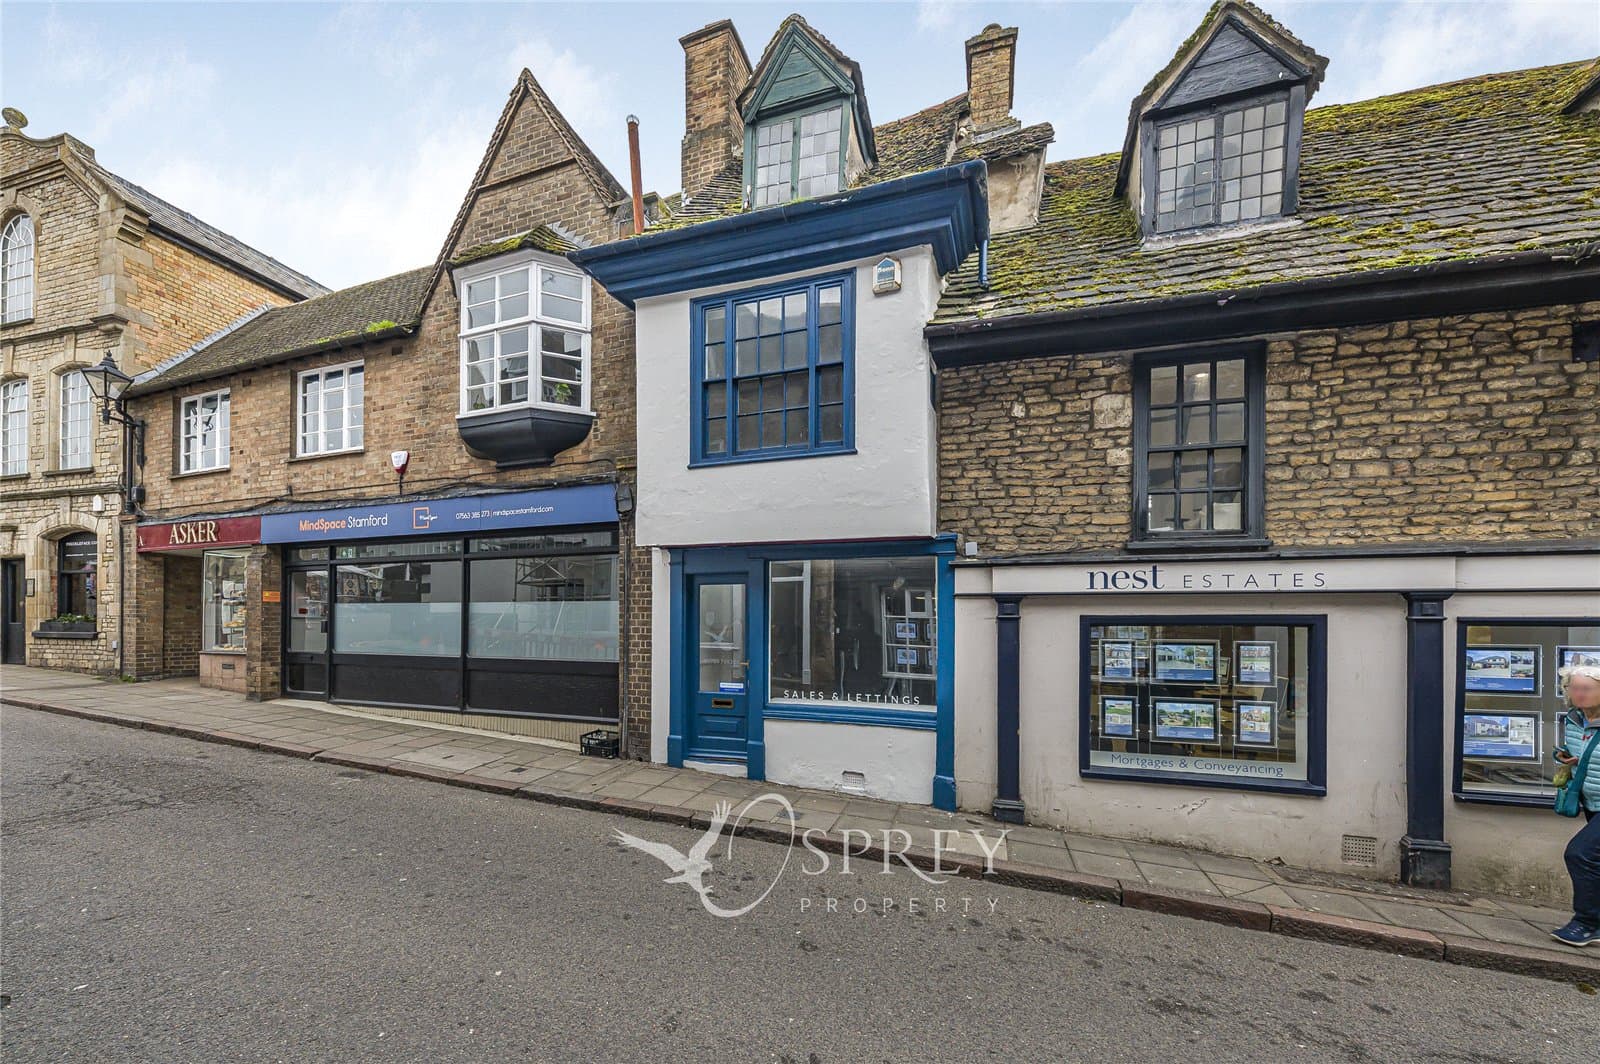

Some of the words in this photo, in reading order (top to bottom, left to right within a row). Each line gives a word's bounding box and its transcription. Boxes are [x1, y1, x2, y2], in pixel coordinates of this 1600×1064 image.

[169, 520, 217, 545] ASKER
[299, 519, 346, 532] MindSpace
[347, 513, 388, 528] Stamford
[1086, 565, 1165, 590] nest
[1183, 573, 1326, 589] ESTATES
[783, 689, 825, 701] SALES
[831, 692, 839, 701] &
[847, 693, 920, 705] LETTINGS
[1111, 753, 1174, 769] Mortgages
[1179, 759, 1189, 769] &
[1194, 759, 1284, 777] Conveyancing
